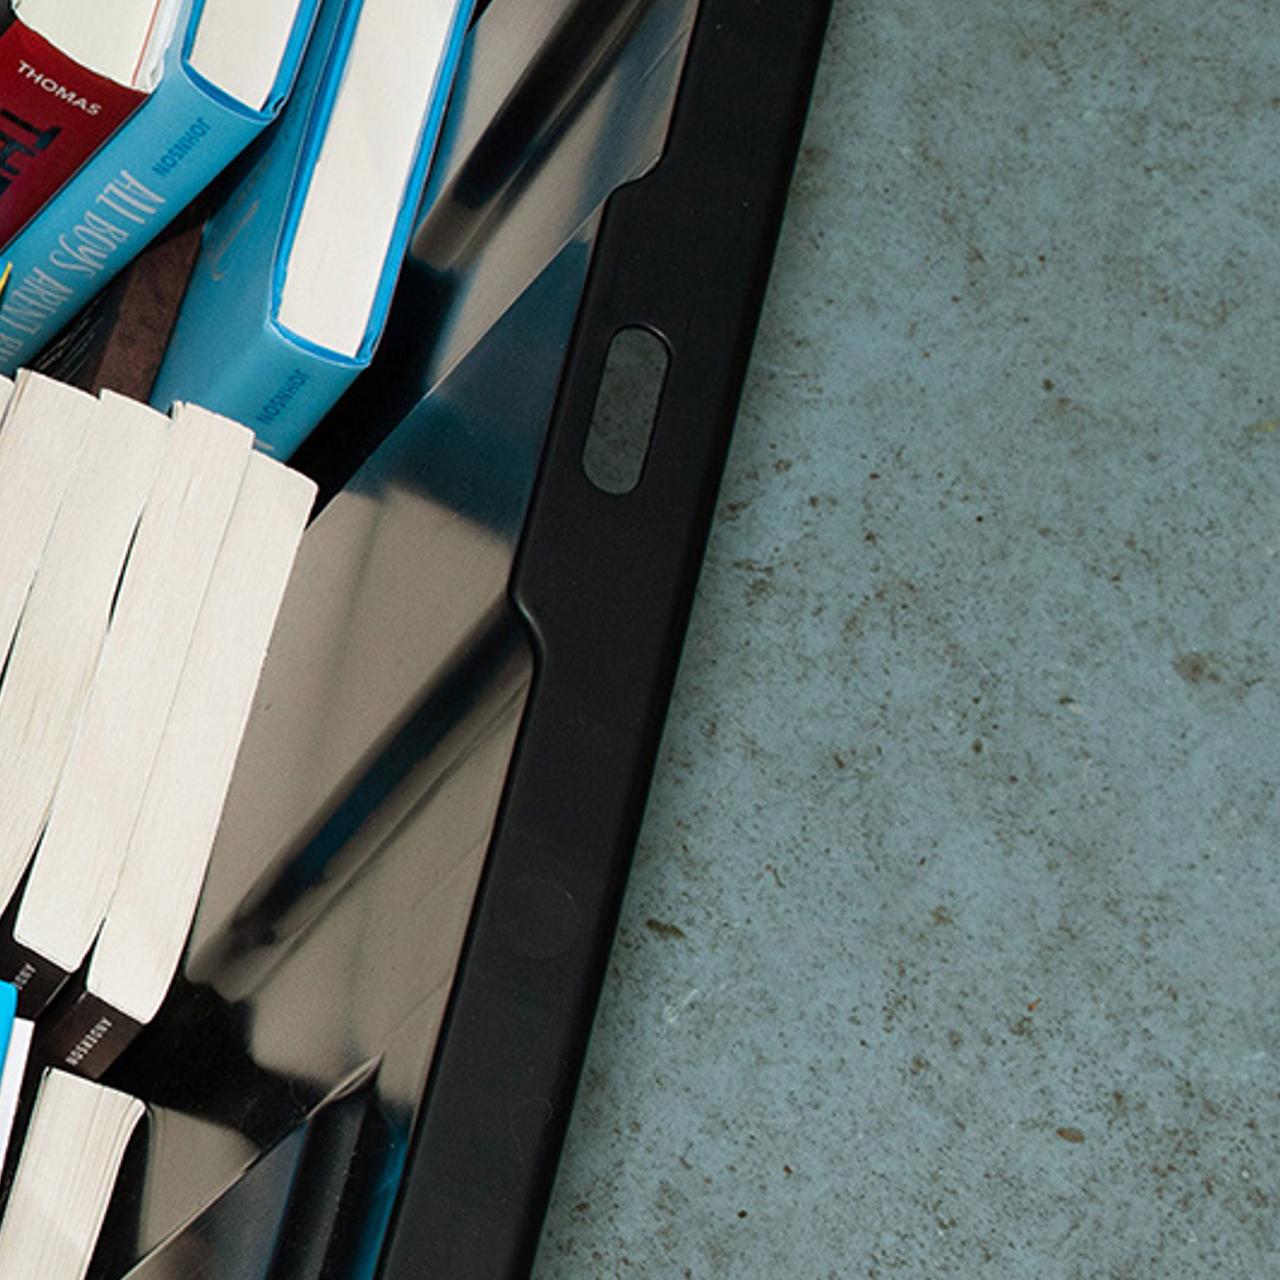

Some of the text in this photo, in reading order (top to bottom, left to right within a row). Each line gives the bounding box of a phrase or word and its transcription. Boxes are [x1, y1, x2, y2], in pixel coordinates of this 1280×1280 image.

[17, 61, 102, 116] THOMAS
[151, 115, 212, 179] JOHNSON
[96, 169, 166, 225] ALL
[50, 210, 132, 278] BOYS
[255, 367, 309, 426] JOHNSON
